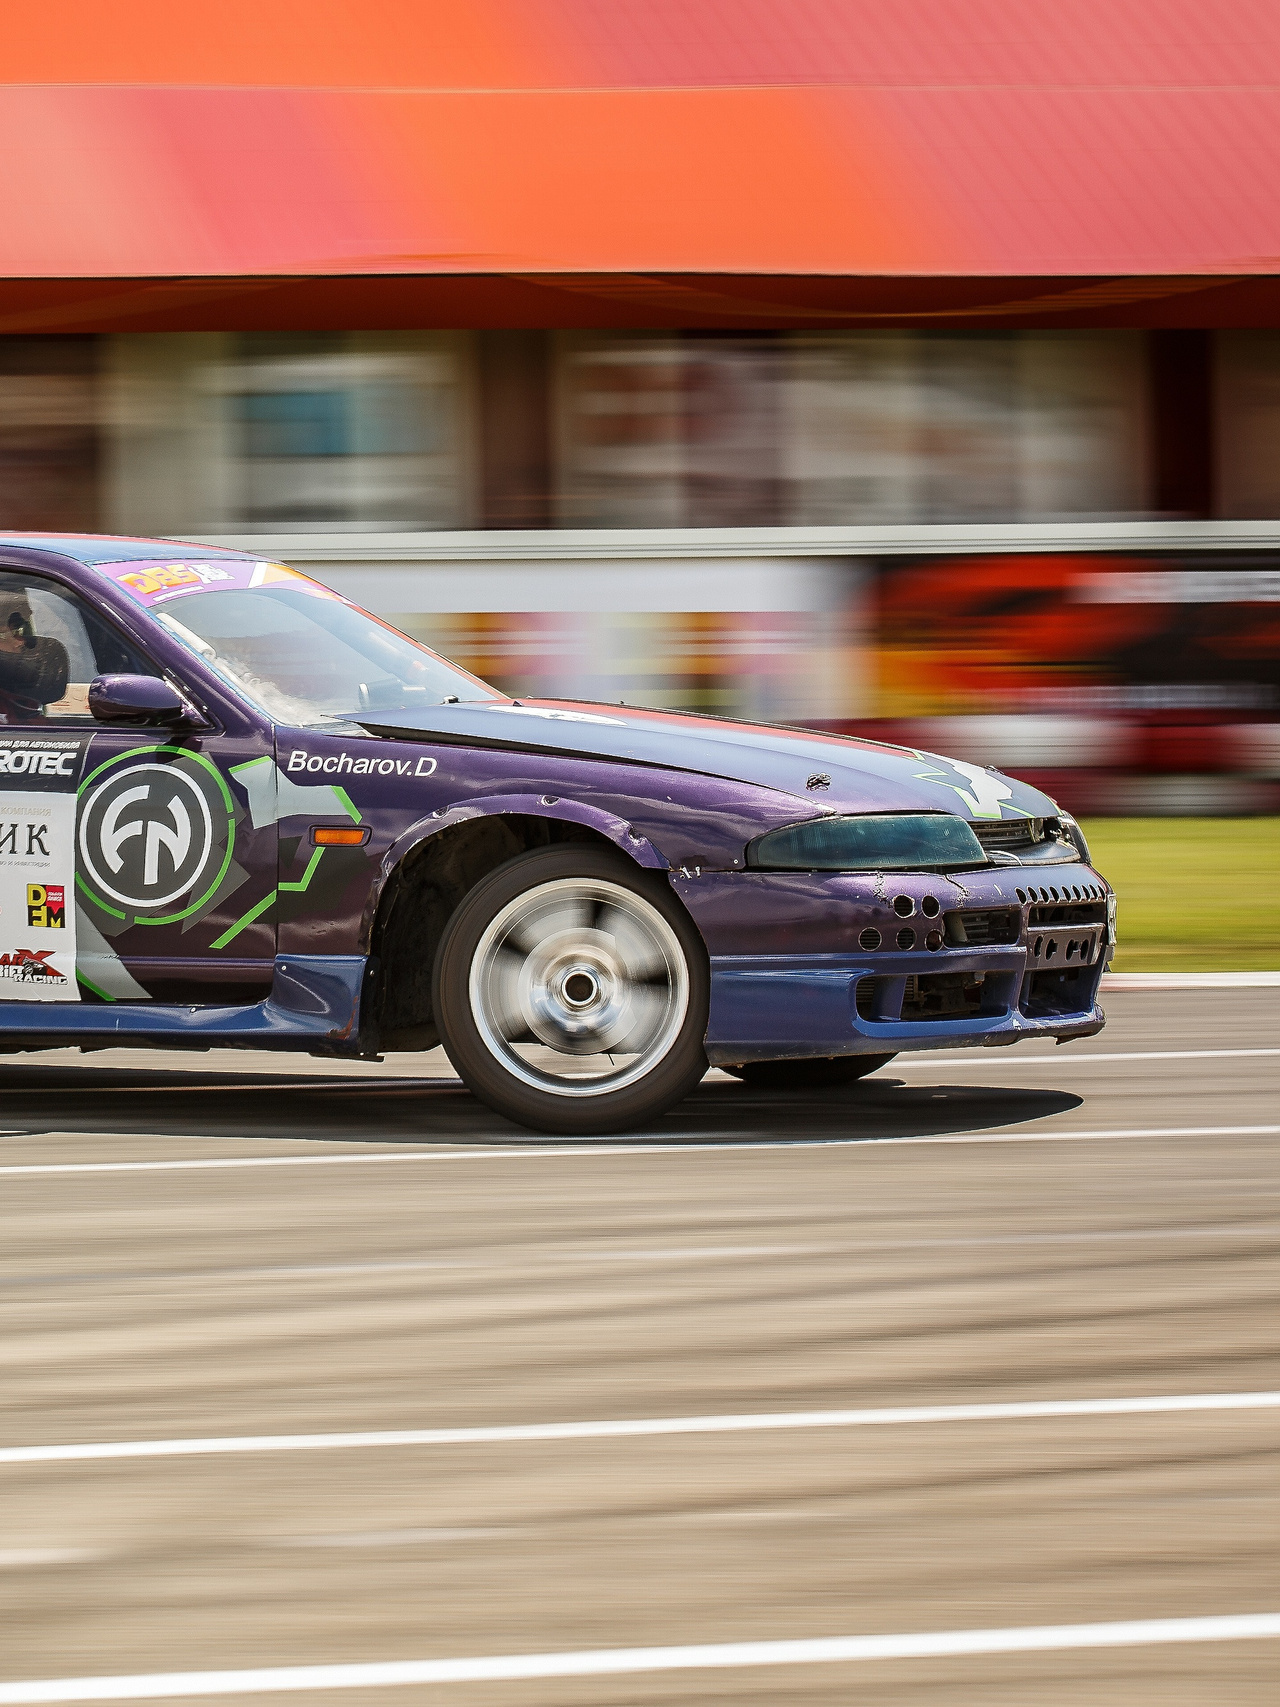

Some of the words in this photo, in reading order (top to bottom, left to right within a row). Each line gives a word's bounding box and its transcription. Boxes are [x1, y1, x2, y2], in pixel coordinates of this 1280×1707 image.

[287, 750, 438, 777] Bocharov.D
[0, 806, 52, 817] КОМПАНИЯ
[13, 973, 69, 986] RACING
